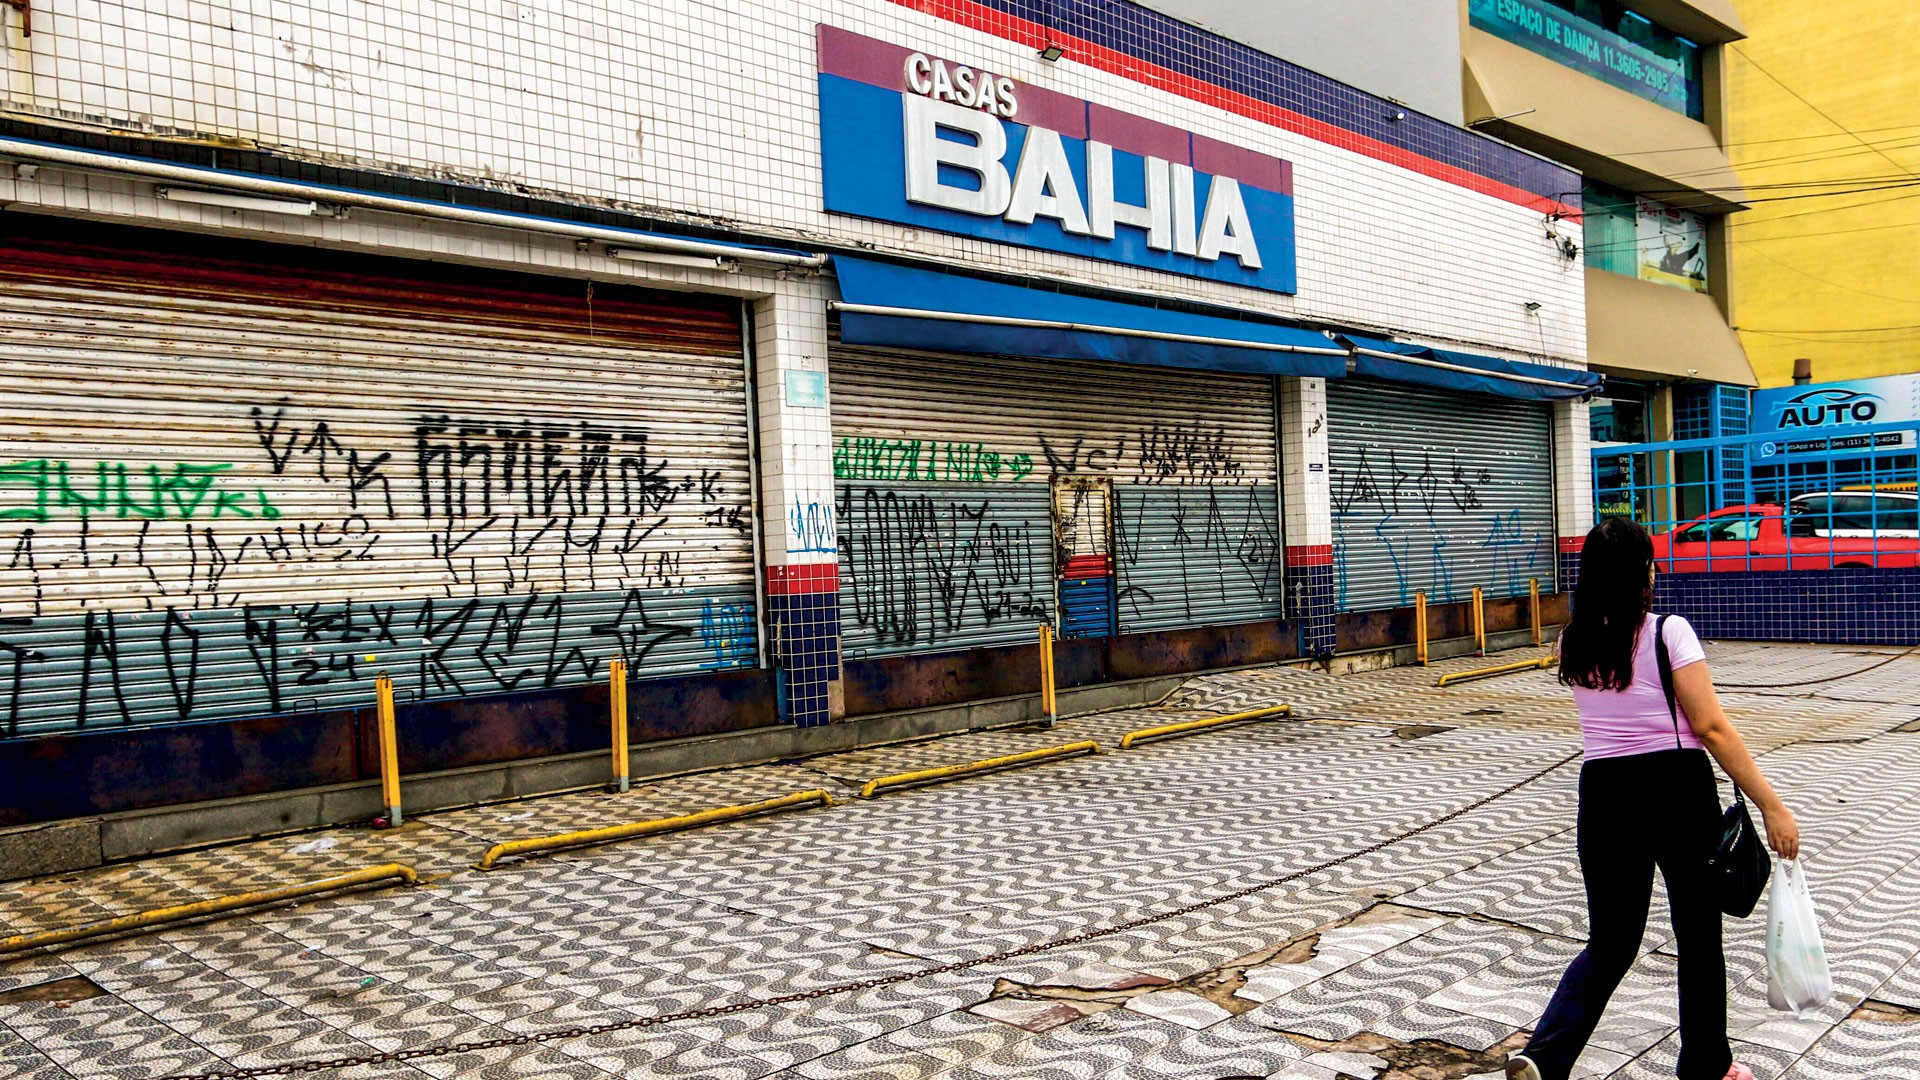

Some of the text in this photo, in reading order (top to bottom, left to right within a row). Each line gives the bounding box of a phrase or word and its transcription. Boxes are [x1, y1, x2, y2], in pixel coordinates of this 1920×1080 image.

[1498, 0, 1542, 35] ESPAÇO
[1546, 16, 1561, 44] DE
[1564, 25, 1600, 62] DANÇA
[903, 52, 1019, 118] CASAS
[901, 92, 1263, 269] BAHIA
[1776, 442, 1808, 452] WtsApp
[1847, 438, 1861, 446] (11)
[1778, 401, 1877, 429] AUTO
